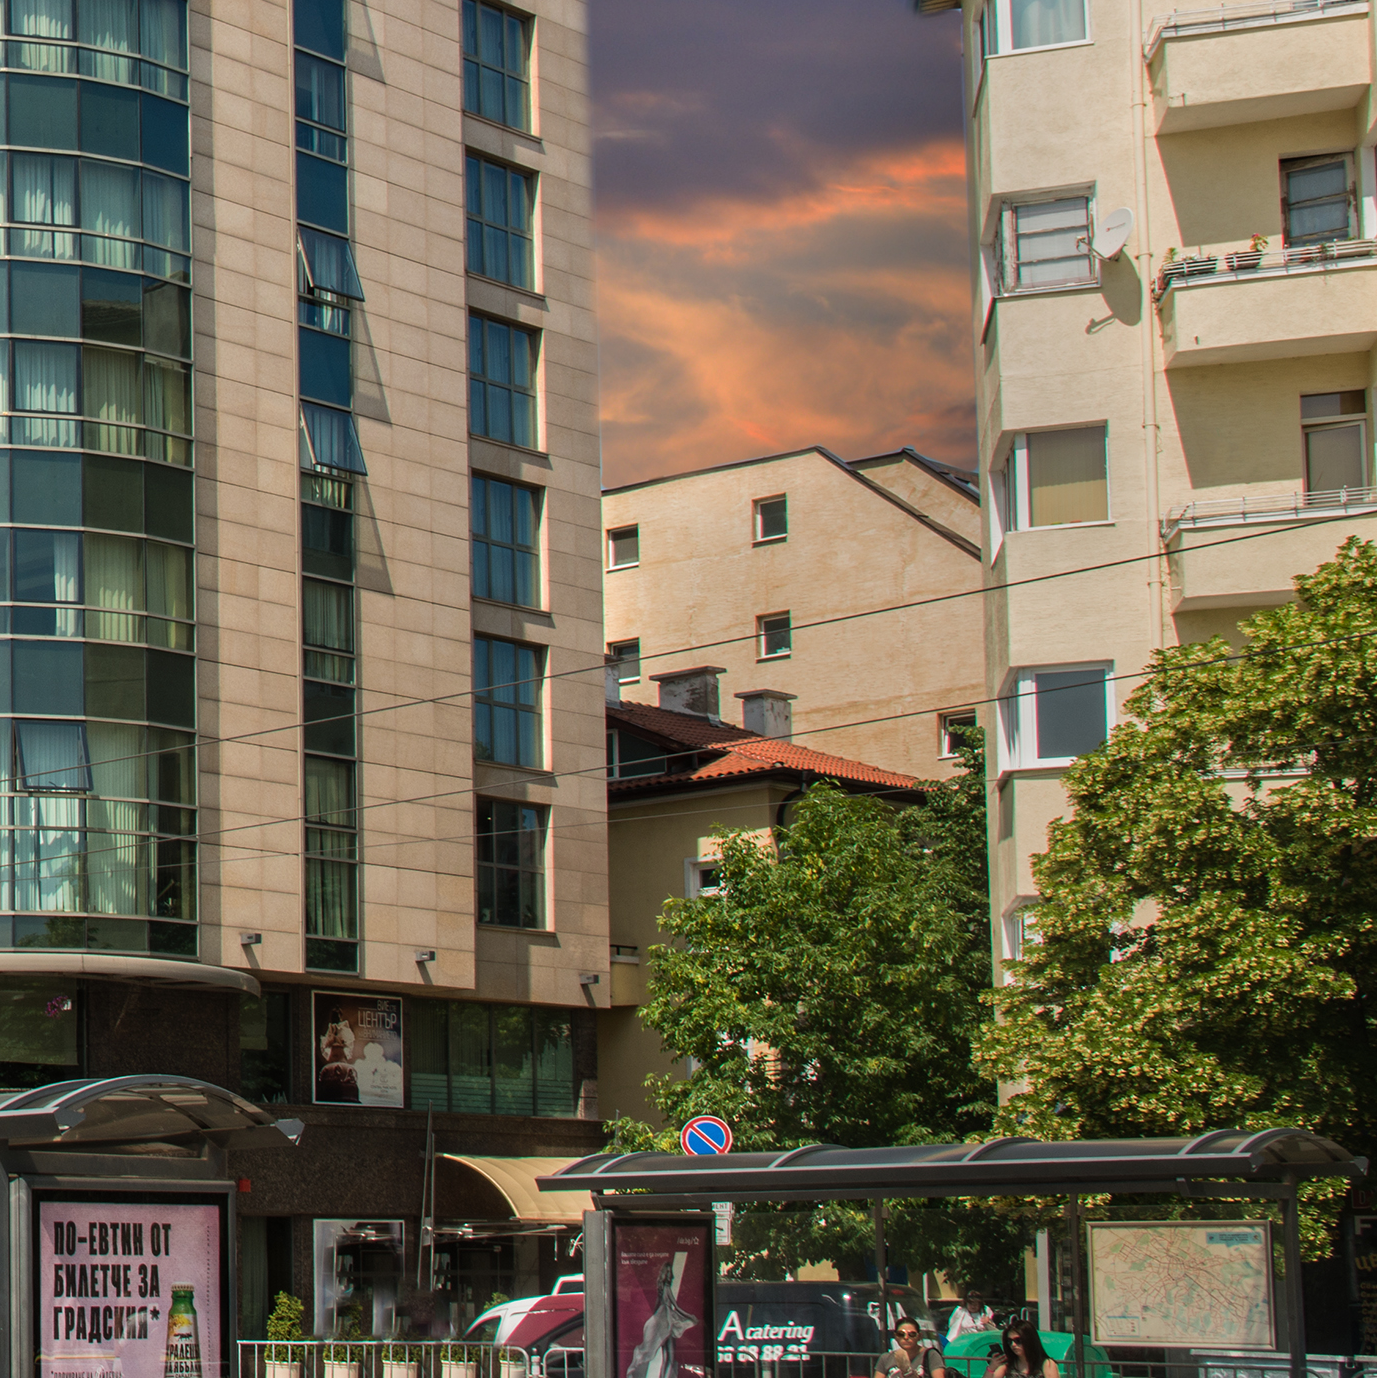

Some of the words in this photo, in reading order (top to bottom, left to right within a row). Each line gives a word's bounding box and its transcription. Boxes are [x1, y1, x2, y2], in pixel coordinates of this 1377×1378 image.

[358, 1010, 397, 1029] ЦЕНТЪР
[53, 1221, 144, 1256] ПО-ЕВТИН
[150, 1222, 172, 1257] ОТ
[53, 1263, 132, 1298] БИЛЕТЧЕ
[138, 1263, 160, 1298] ЗА
[717, 1310, 745, 1341] A
[745, 1320, 815, 1343] catering
